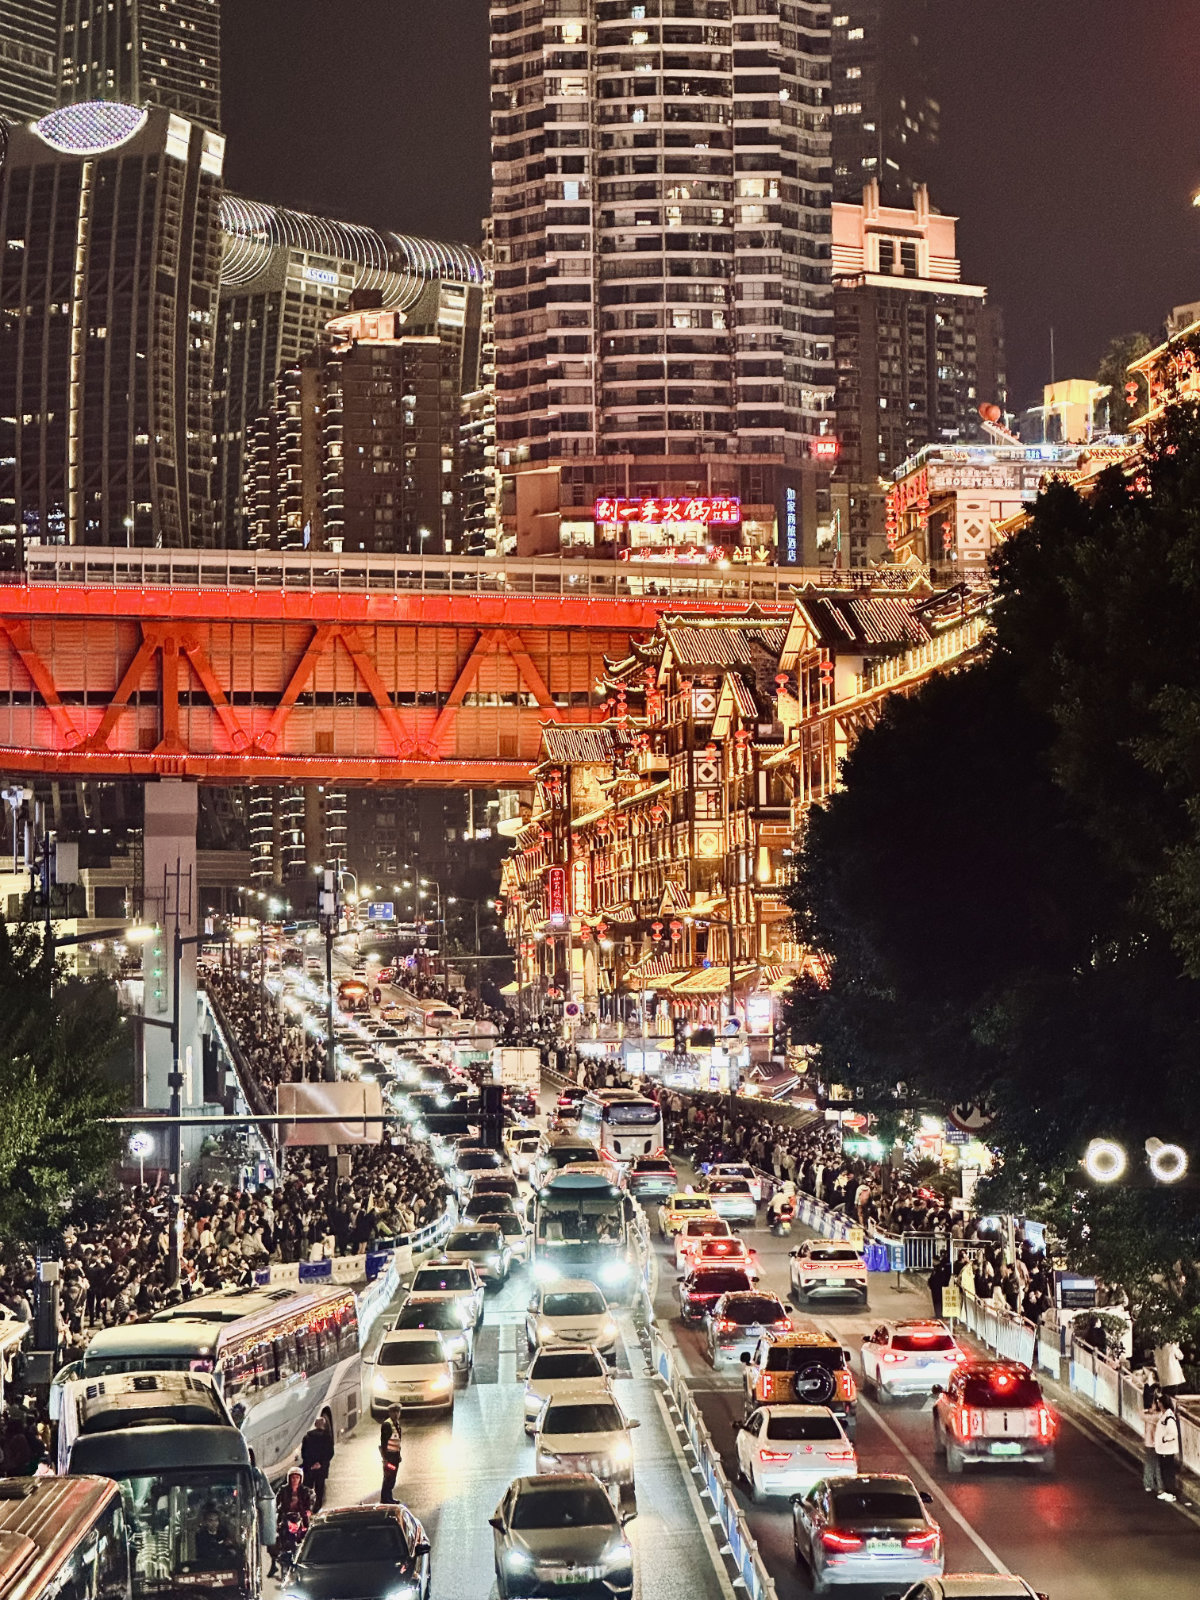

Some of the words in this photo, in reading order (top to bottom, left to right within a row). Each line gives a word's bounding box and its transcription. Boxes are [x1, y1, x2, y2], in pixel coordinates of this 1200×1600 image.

[598, 500, 710, 521] 刘一手火锅
[786, 487, 797, 562] 如家商旅酒店
